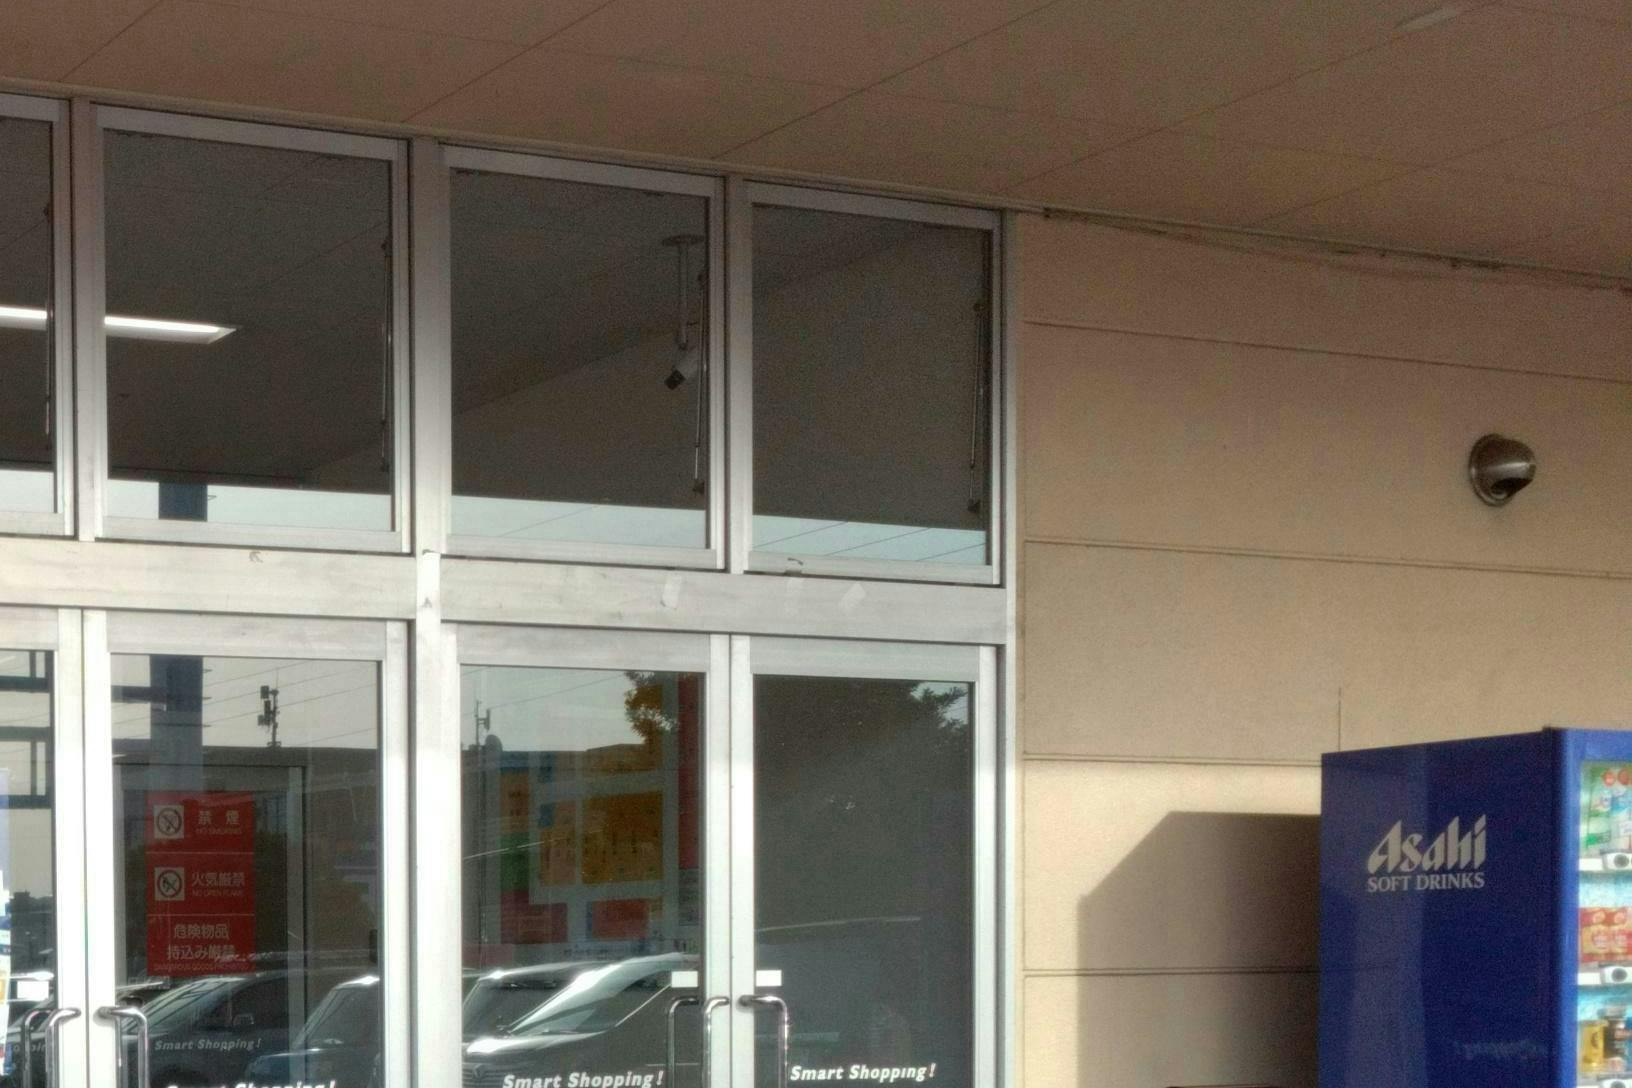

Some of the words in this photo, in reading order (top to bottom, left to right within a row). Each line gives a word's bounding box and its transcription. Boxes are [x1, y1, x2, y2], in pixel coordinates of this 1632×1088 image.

[1367, 814, 1486, 874] Asahi
[1368, 876, 1412, 893] SOFT
[1416, 872, 1485, 890] DRINKS
[790, 1065, 843, 1081] Smart
